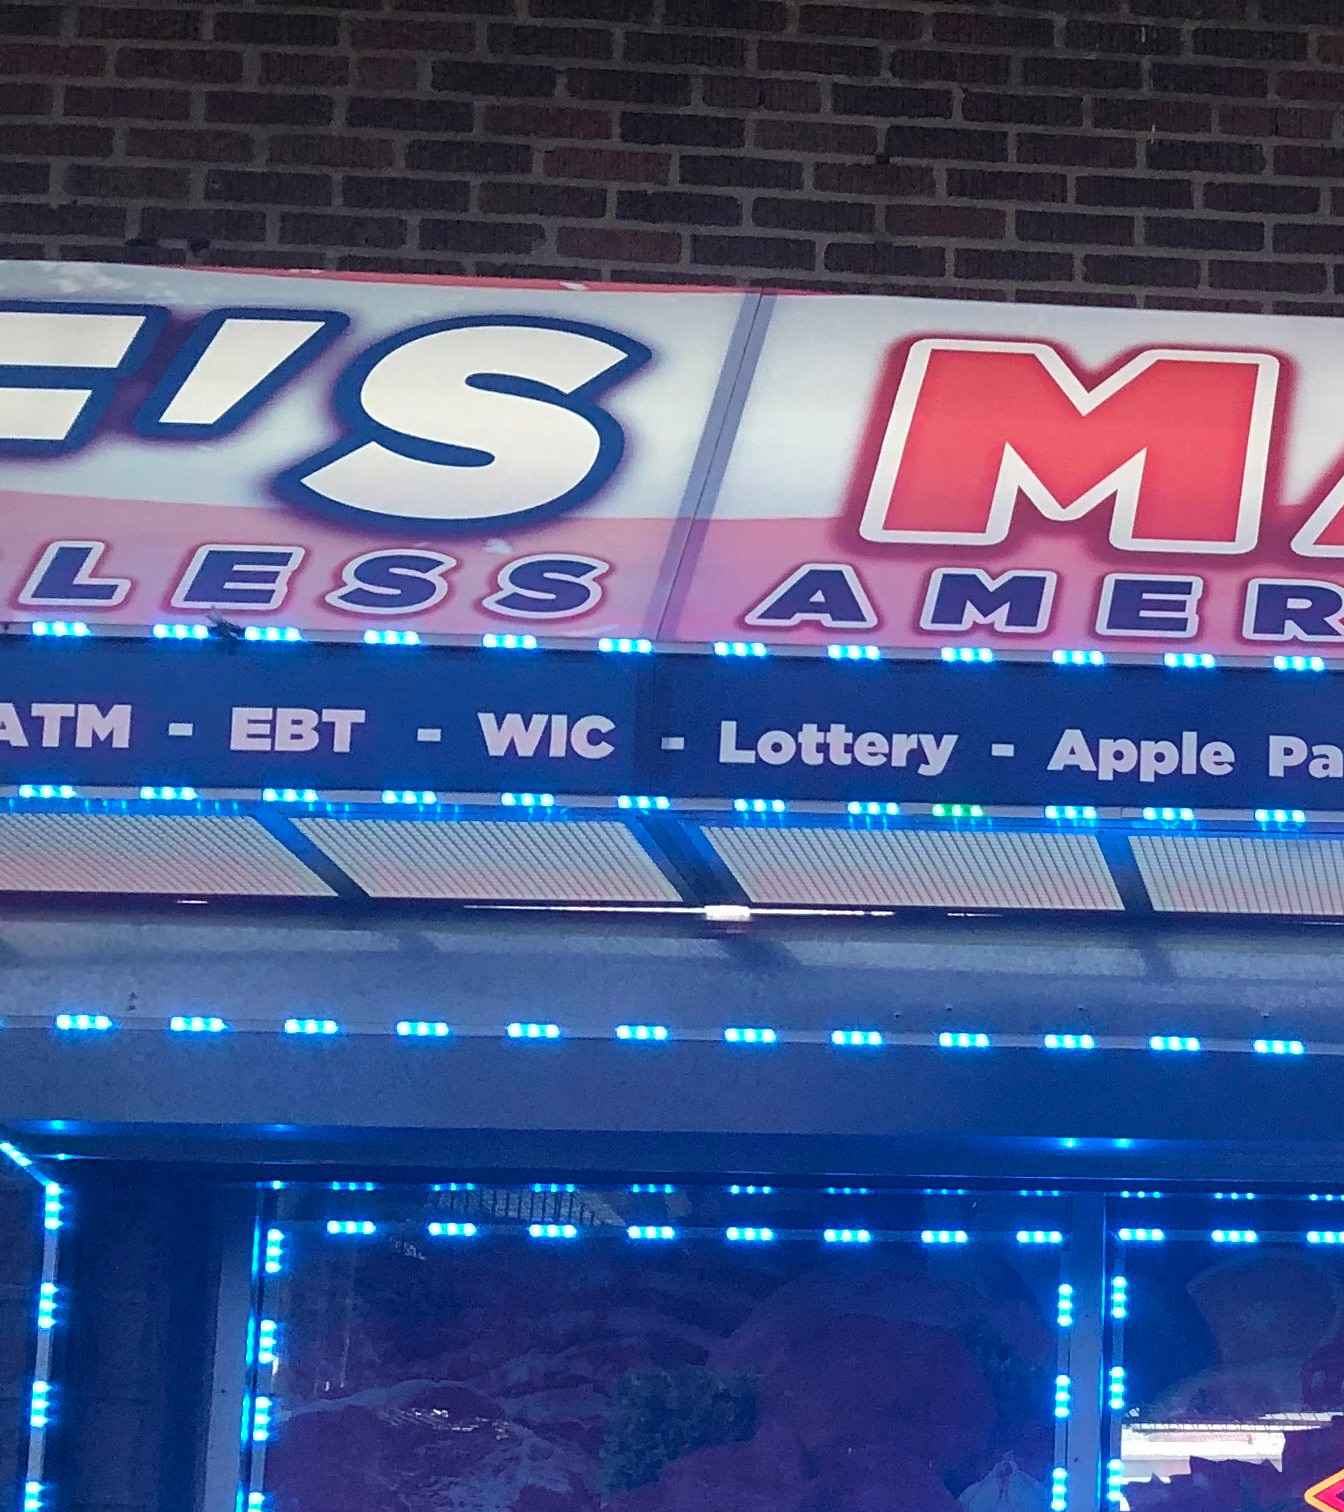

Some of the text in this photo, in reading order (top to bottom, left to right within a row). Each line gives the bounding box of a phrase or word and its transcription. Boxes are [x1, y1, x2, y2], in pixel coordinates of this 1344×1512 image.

[229, 706, 366, 753] EBT
[477, 711, 616, 759] WIC
[718, 720, 959, 778] Lottery
[1047, 730, 1235, 784] Apple
